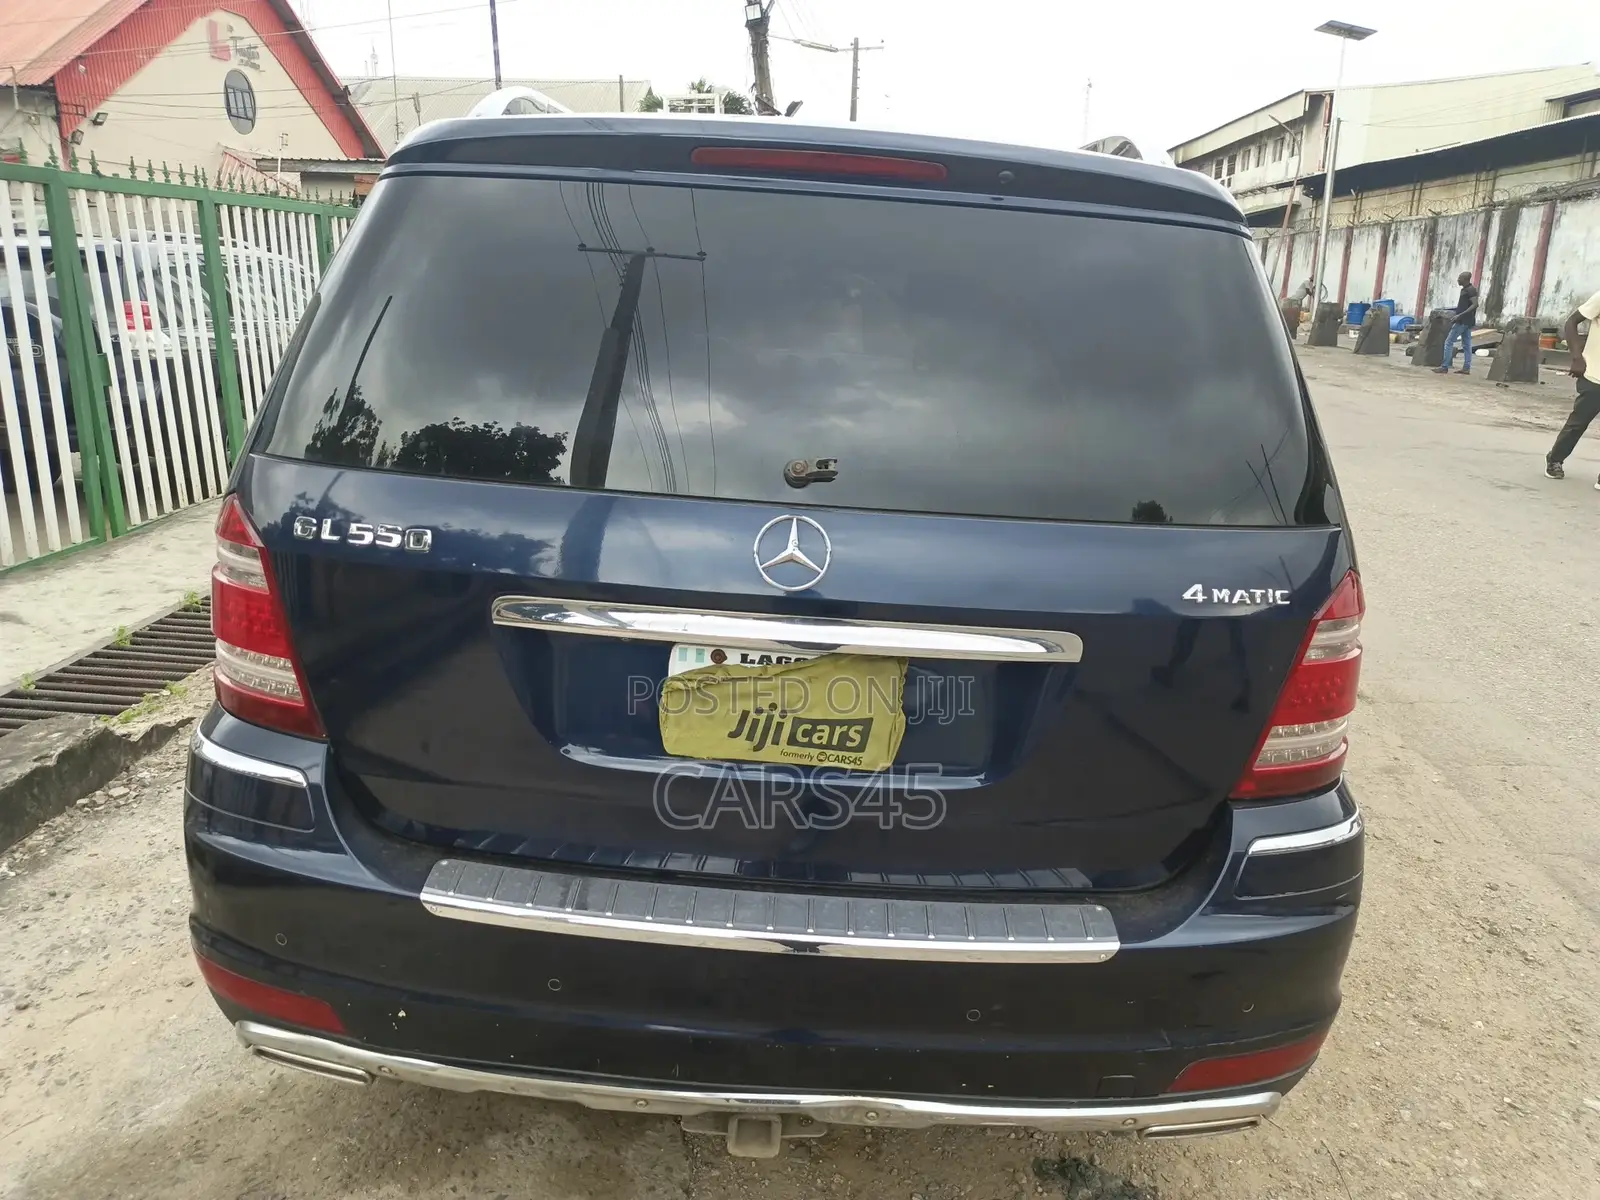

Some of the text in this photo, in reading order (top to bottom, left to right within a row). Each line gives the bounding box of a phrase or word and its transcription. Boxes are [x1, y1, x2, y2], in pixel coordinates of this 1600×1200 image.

[727, 702, 864, 752] Jiji cars
[780, 748, 864, 766] formerly CARS45
